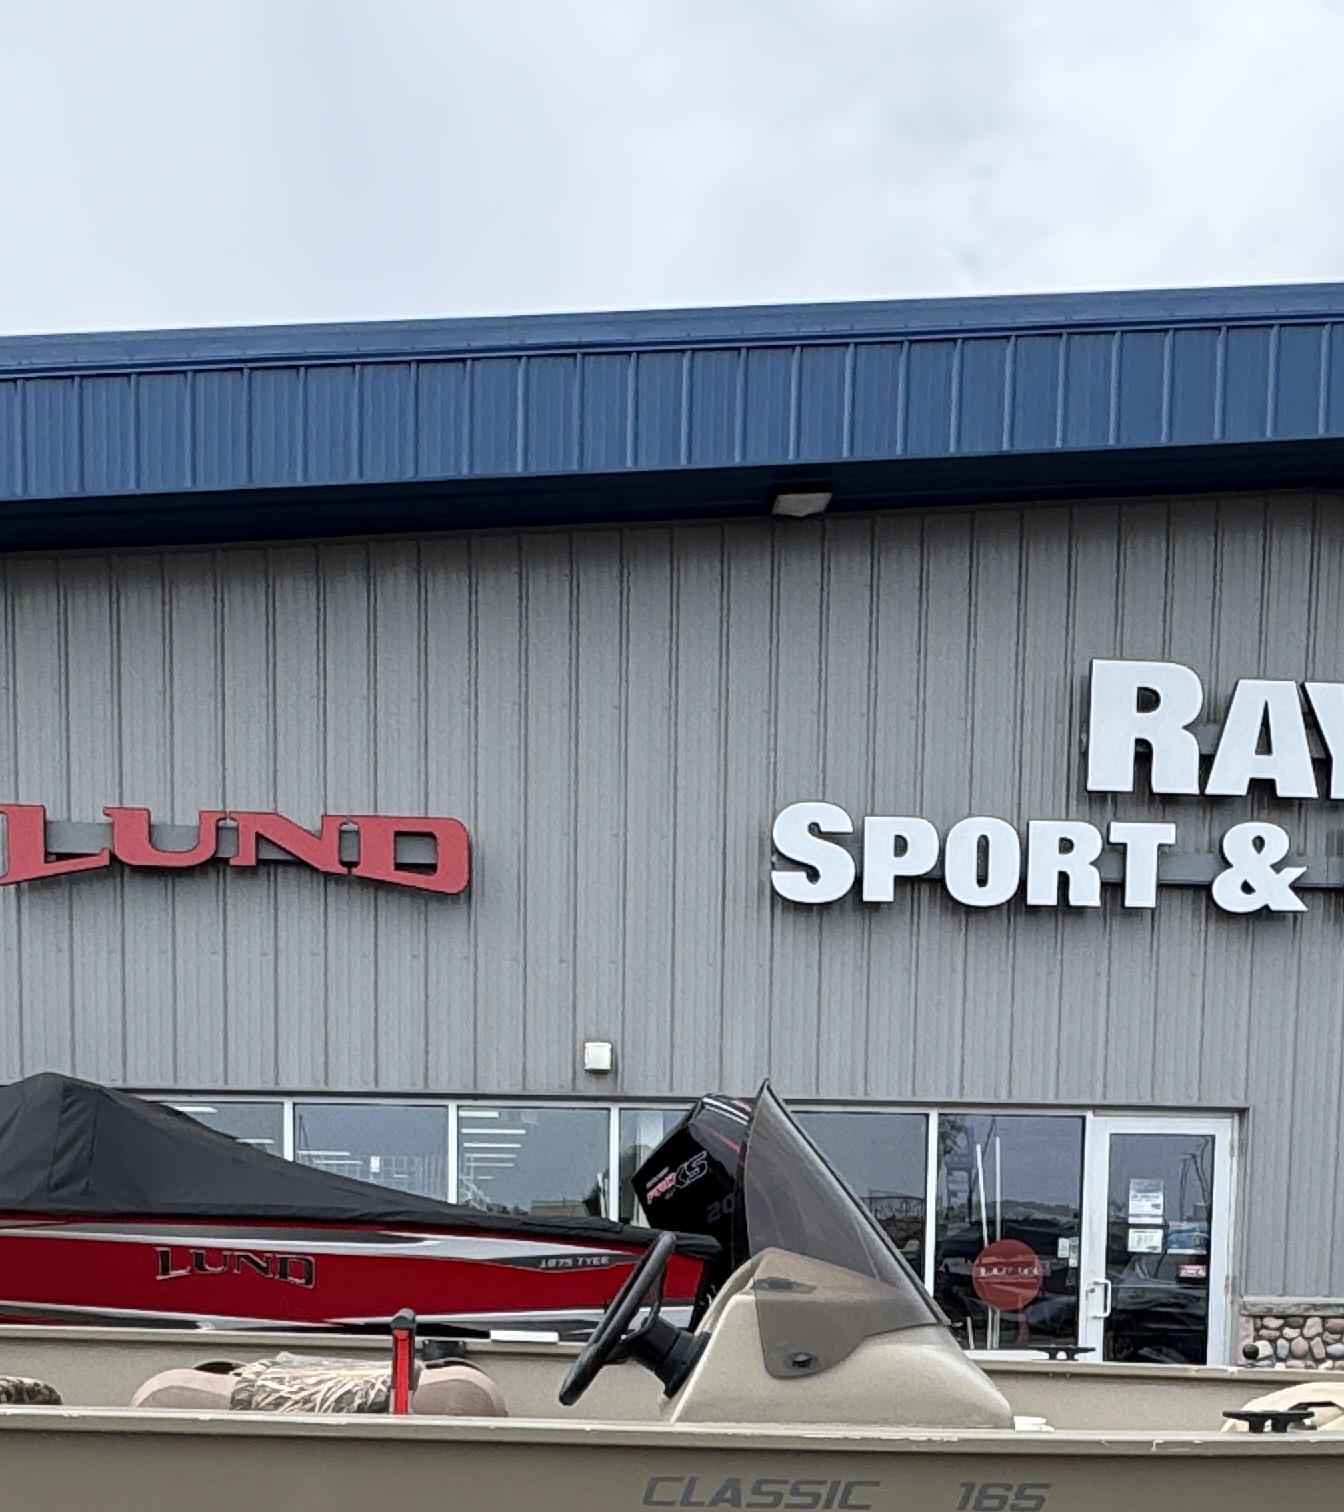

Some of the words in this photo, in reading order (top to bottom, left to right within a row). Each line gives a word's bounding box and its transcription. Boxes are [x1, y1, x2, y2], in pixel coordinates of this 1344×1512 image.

[770, 801, 1176, 909] SPORT
[1210, 822, 1309, 916] &
[153, 1246, 316, 1290] LUND
[642, 1475, 882, 1511] CLASSIC
[956, 1480, 1053, 1512] 165
